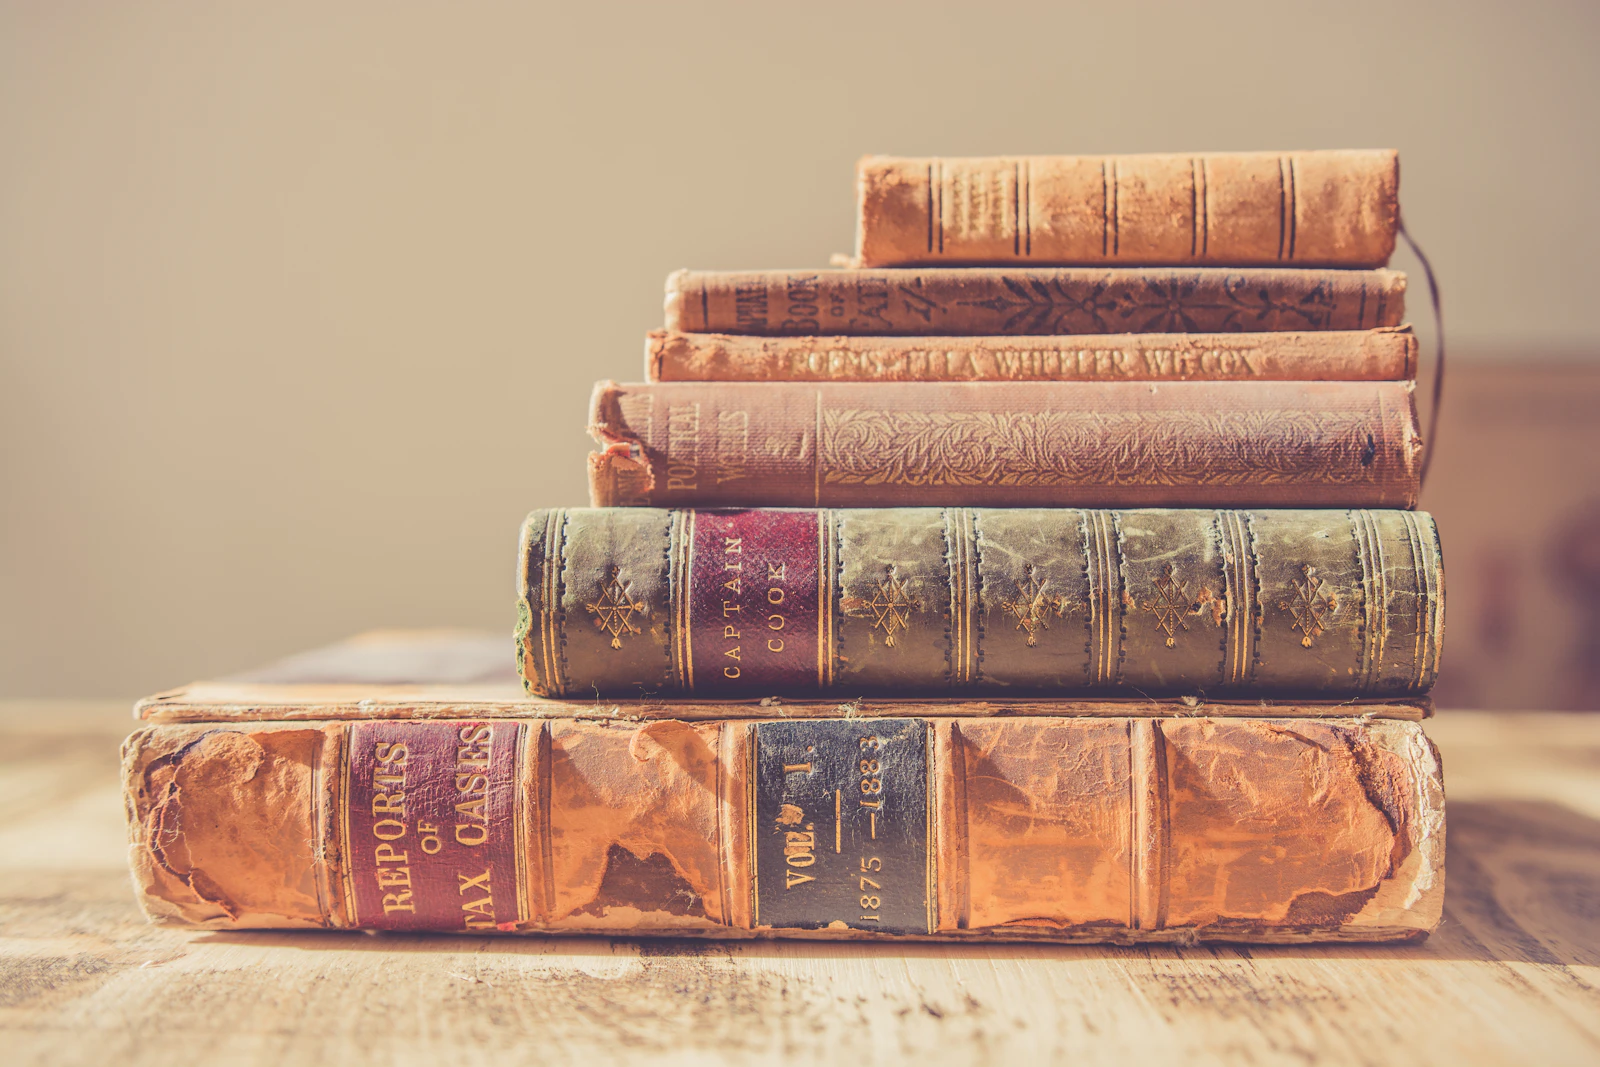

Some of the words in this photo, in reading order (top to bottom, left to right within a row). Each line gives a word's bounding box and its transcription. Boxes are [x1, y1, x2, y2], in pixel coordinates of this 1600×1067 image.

[667, 402, 700, 491] POETICAL
[767, 562, 786, 653] COOK
[372, 742, 416, 916] REPORTS
[454, 723, 494, 846] CASES
[417, 819, 442, 855] OF
[458, 868, 497, 930] TAX
